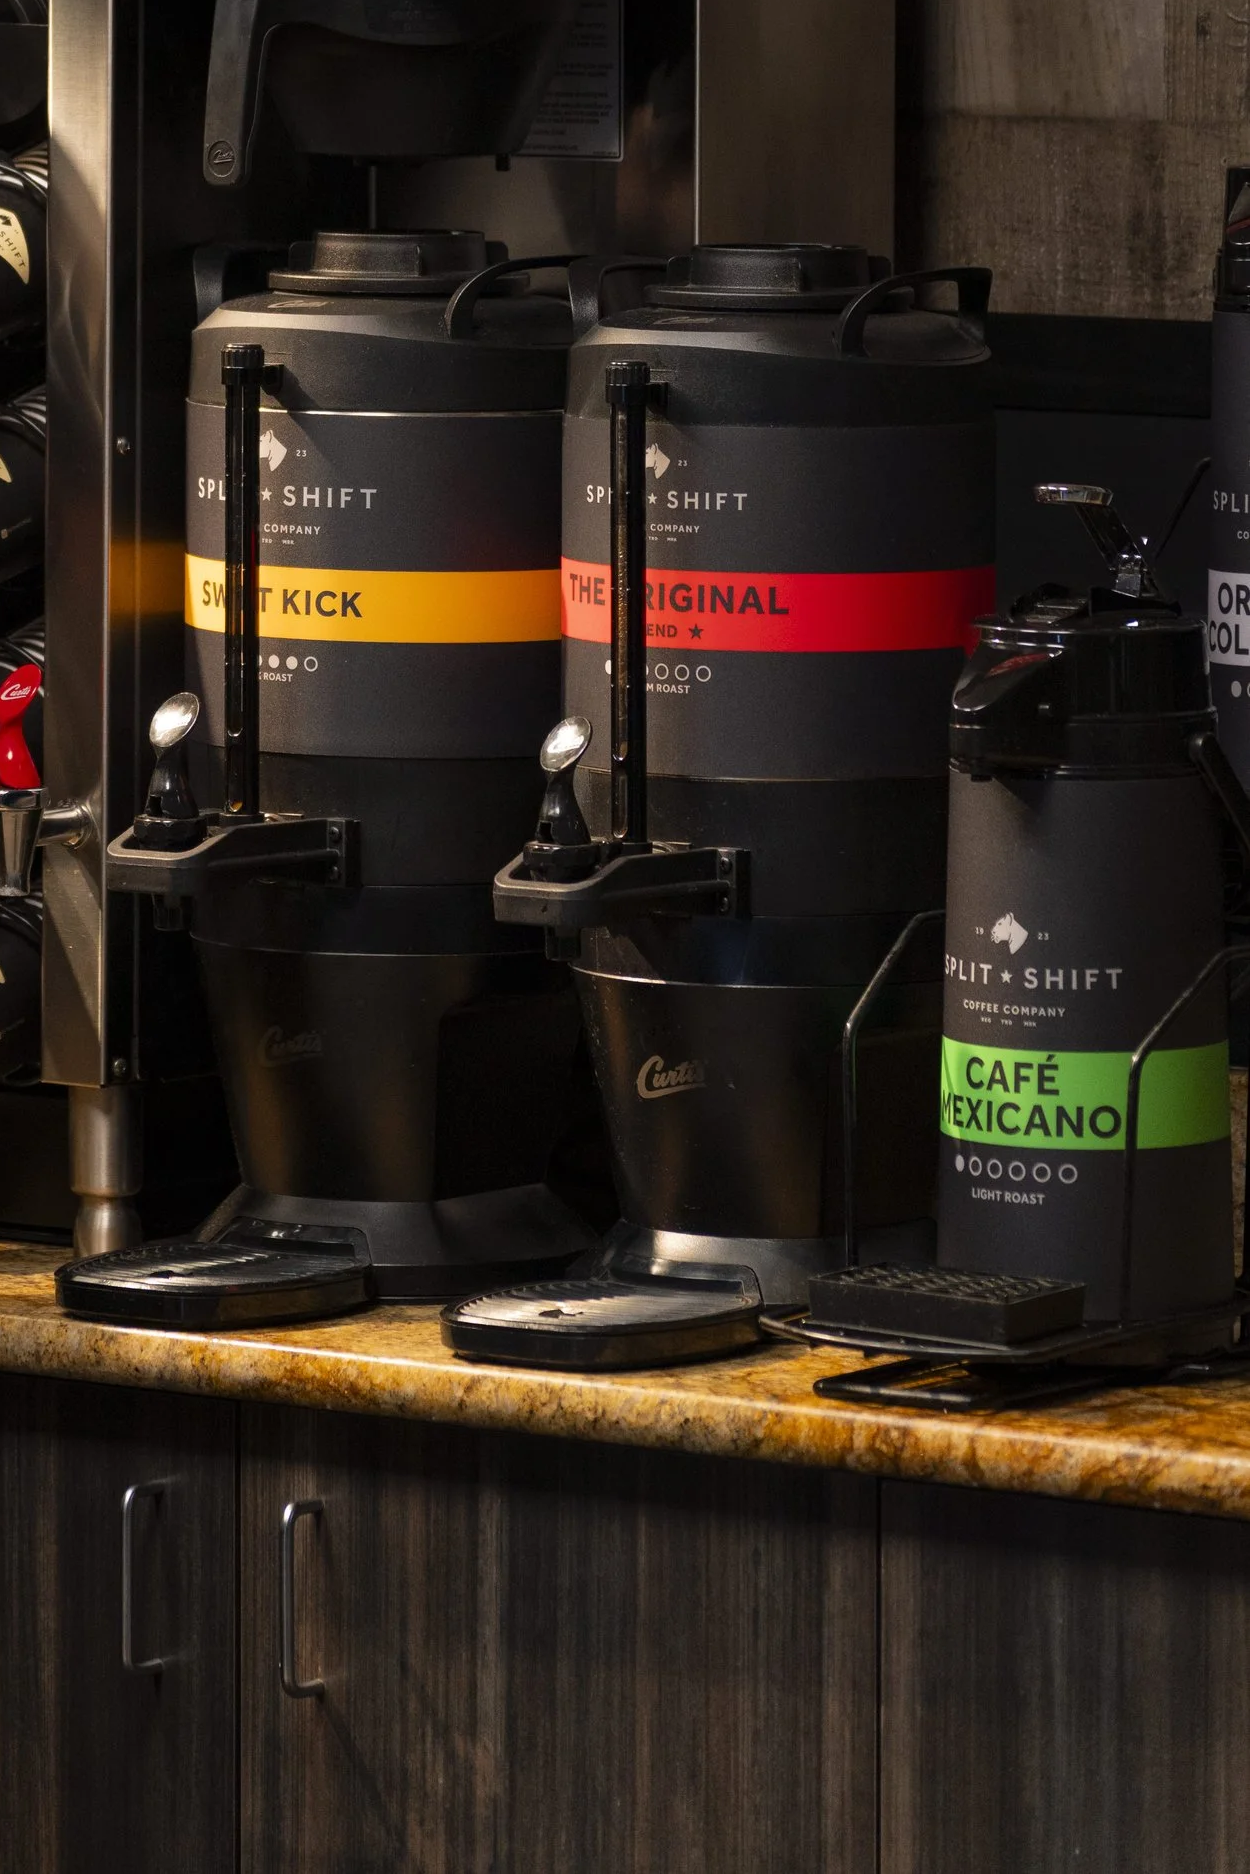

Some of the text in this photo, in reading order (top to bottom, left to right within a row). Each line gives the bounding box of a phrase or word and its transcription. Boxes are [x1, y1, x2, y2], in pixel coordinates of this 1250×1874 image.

[296, 449, 307, 457] 23
[198, 477, 378, 509] SPL SHIFT
[667, 490, 748, 511] SHIFT
[1213, 489, 1250, 514] SPLI
[263, 523, 322, 535] COMPANY
[650, 523, 700, 534] COMPANY
[1237, 530, 1250, 540] CO
[202, 579, 363, 618] SWT KICK
[569, 573, 789, 616] THE RIGINAL
[1218, 582, 1250, 616] OR
[646, 623, 678, 639] END
[1209, 620, 1250, 656] COL
[263, 672, 293, 683] ROAST
[656, 683, 691, 695] ROAST
[975, 926, 984, 935] 19
[1037, 932, 1049, 941] 23
[944, 953, 1123, 991] SPLIT SHIFT
[962, 999, 1066, 1018] COFFEE COMPANY
[965, 1053, 1060, 1096] CAFÉ
[941, 1089, 1122, 1139] MEXICANO
[971, 1186, 1046, 1206] LIGHT ROAST
